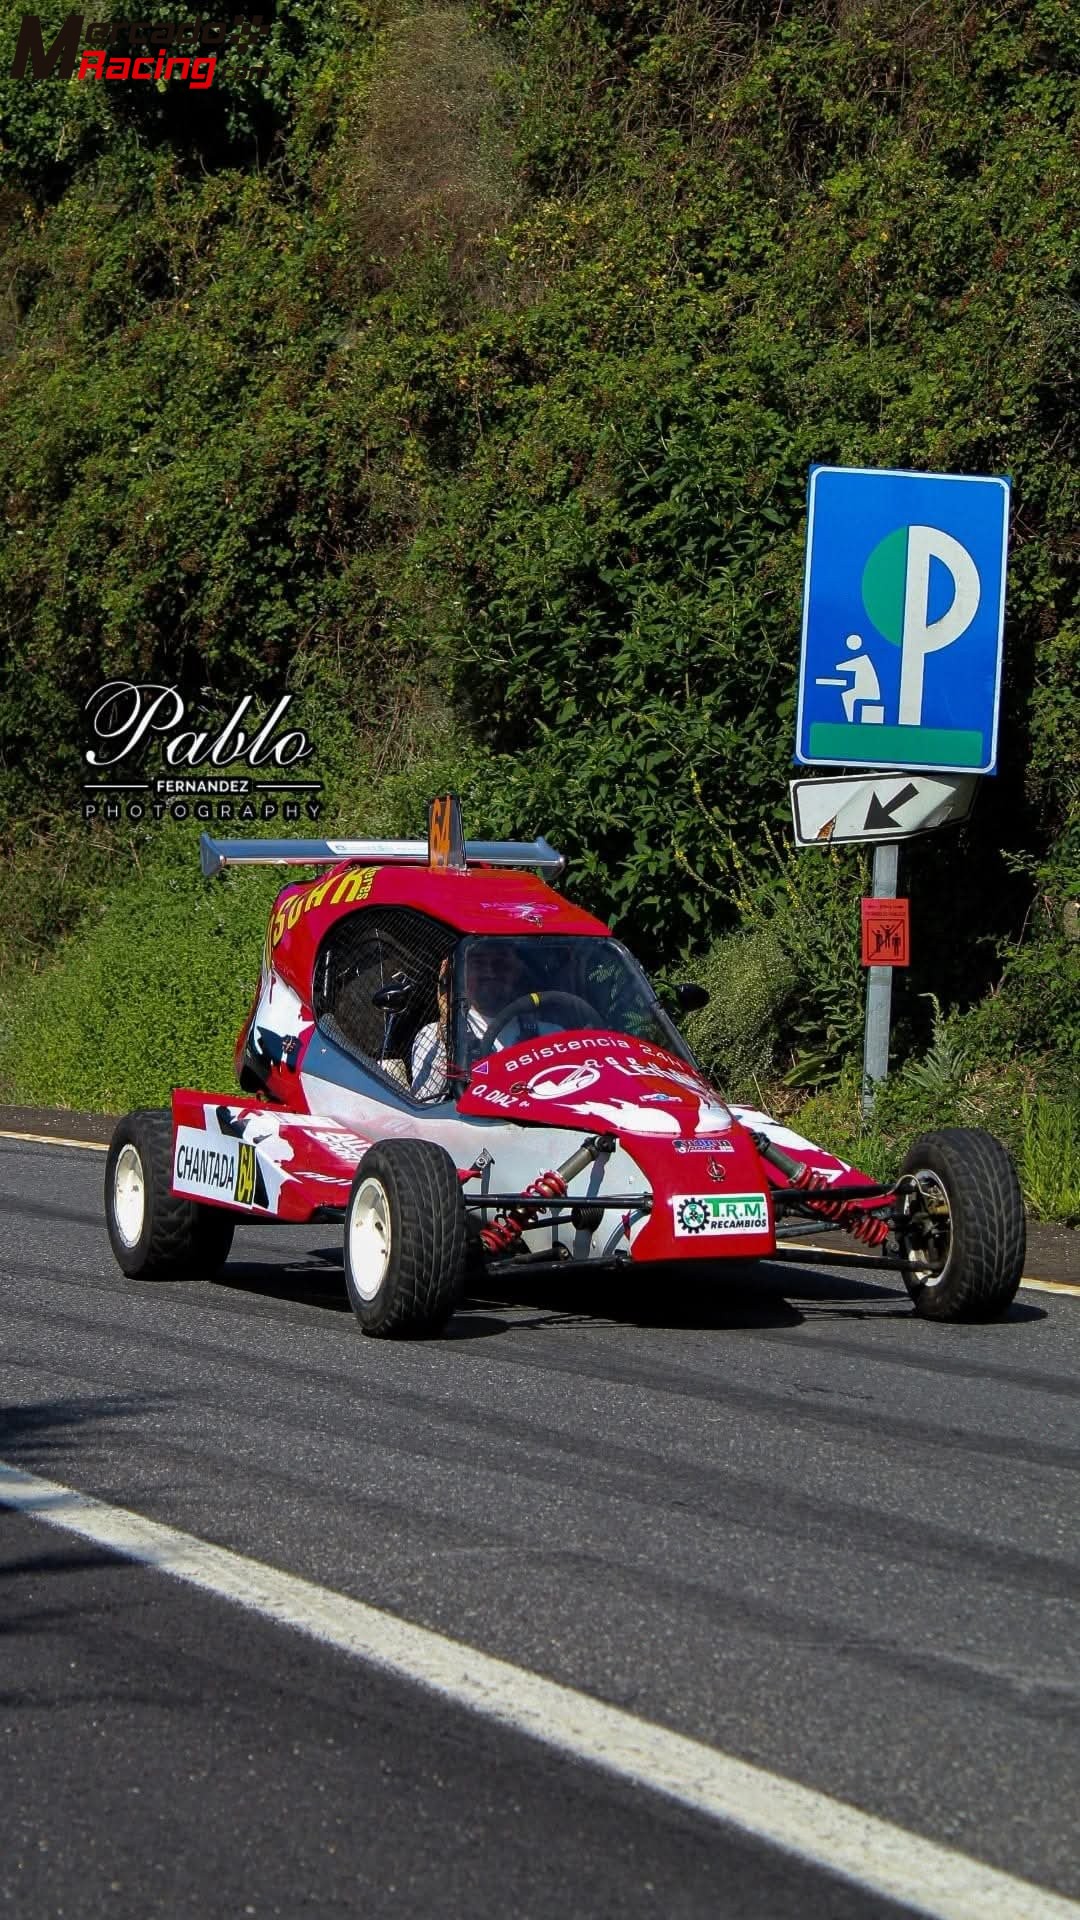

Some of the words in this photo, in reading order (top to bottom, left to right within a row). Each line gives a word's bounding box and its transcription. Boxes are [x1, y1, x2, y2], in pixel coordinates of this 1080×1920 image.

[430, 796, 452, 868] 64
[504, 1036, 630, 1072] asistencia
[485, 1090, 518, 1108] DIAZ
[176, 1144, 234, 1191] CHANTADA
[238, 1145, 253, 1202] 64
[703, 1196, 766, 1219] T.R.M.
[710, 1218, 767, 1230] RECAMBIOS
